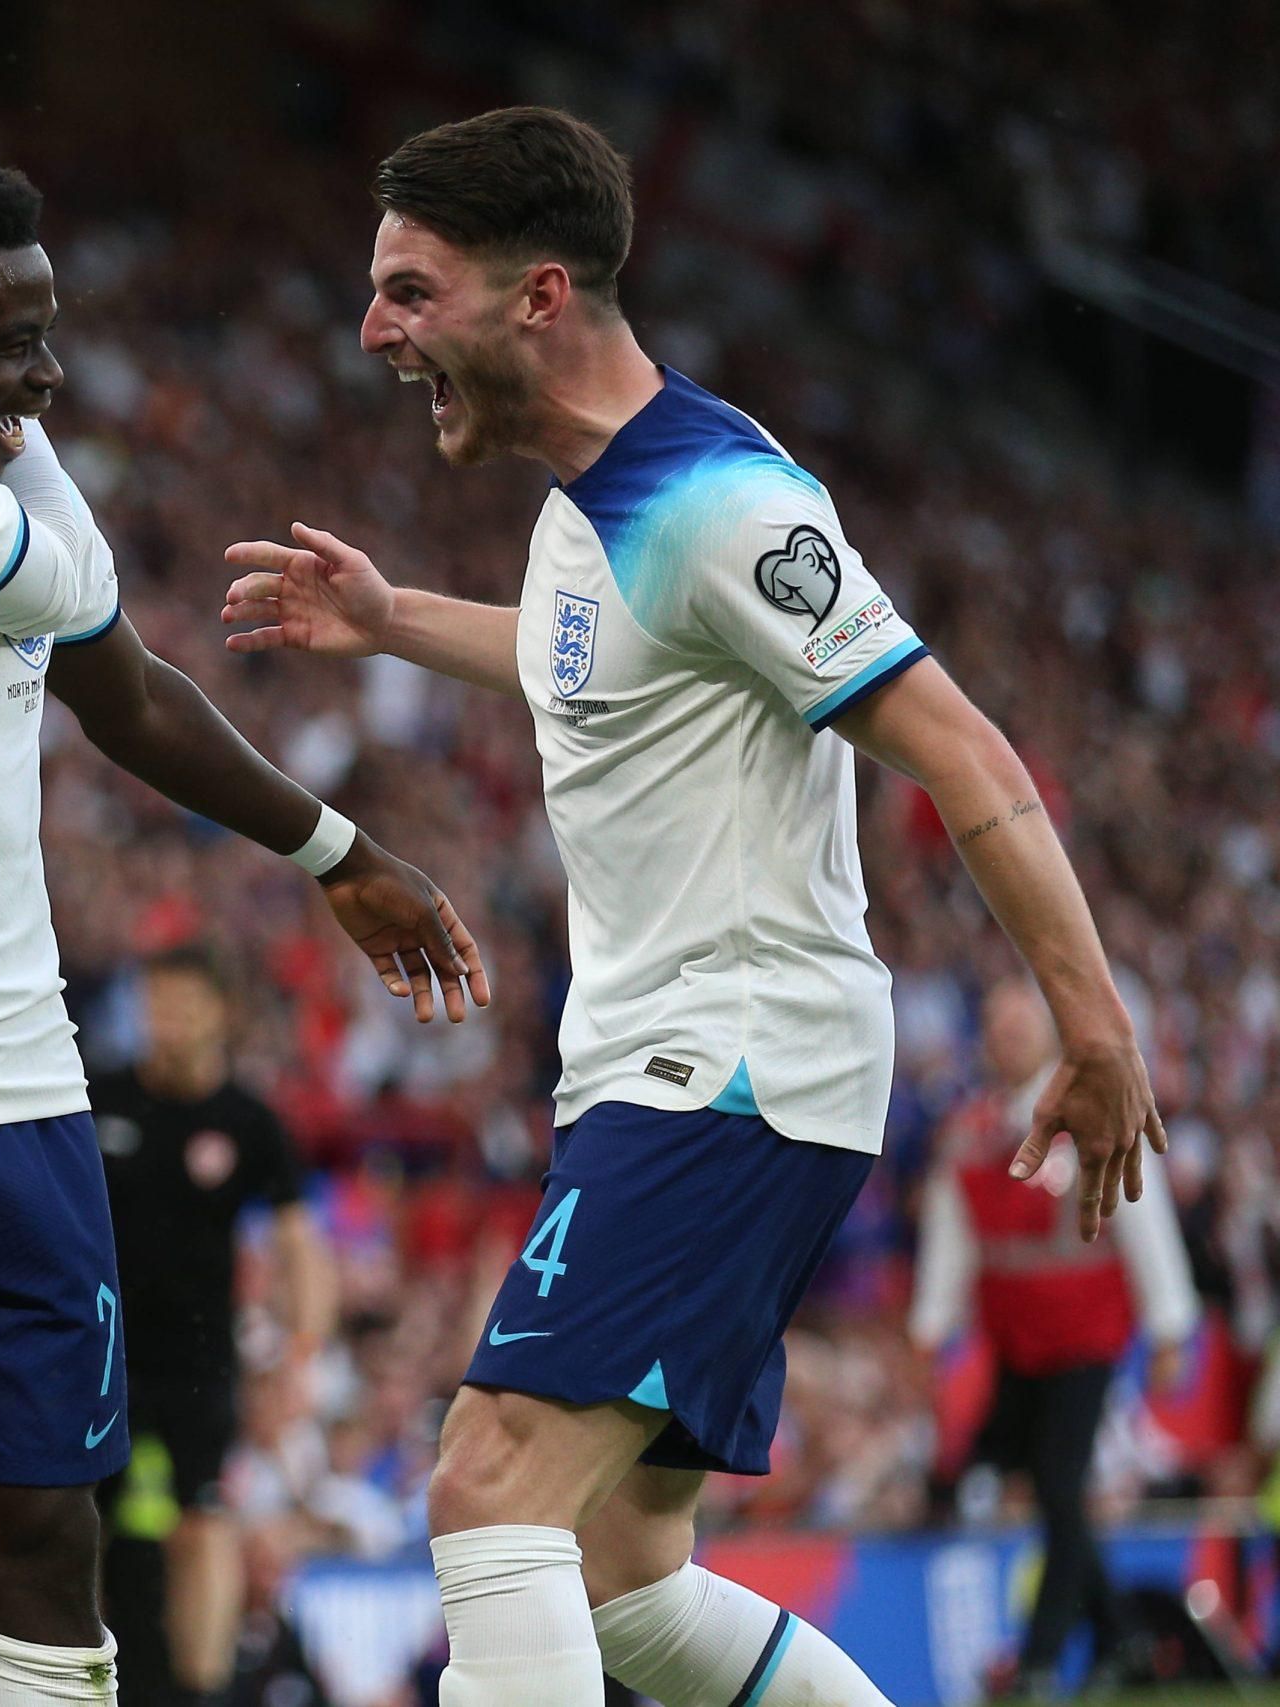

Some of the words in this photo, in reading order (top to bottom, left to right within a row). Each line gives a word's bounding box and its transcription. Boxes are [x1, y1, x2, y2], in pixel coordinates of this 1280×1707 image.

[801, 636, 821, 656] UEFA
[806, 597, 888, 667] FOUNDATION
[7, 680, 30, 700] NORTH
[521, 1188, 581, 1297] 4
[96, 1282, 116, 1397] 7
